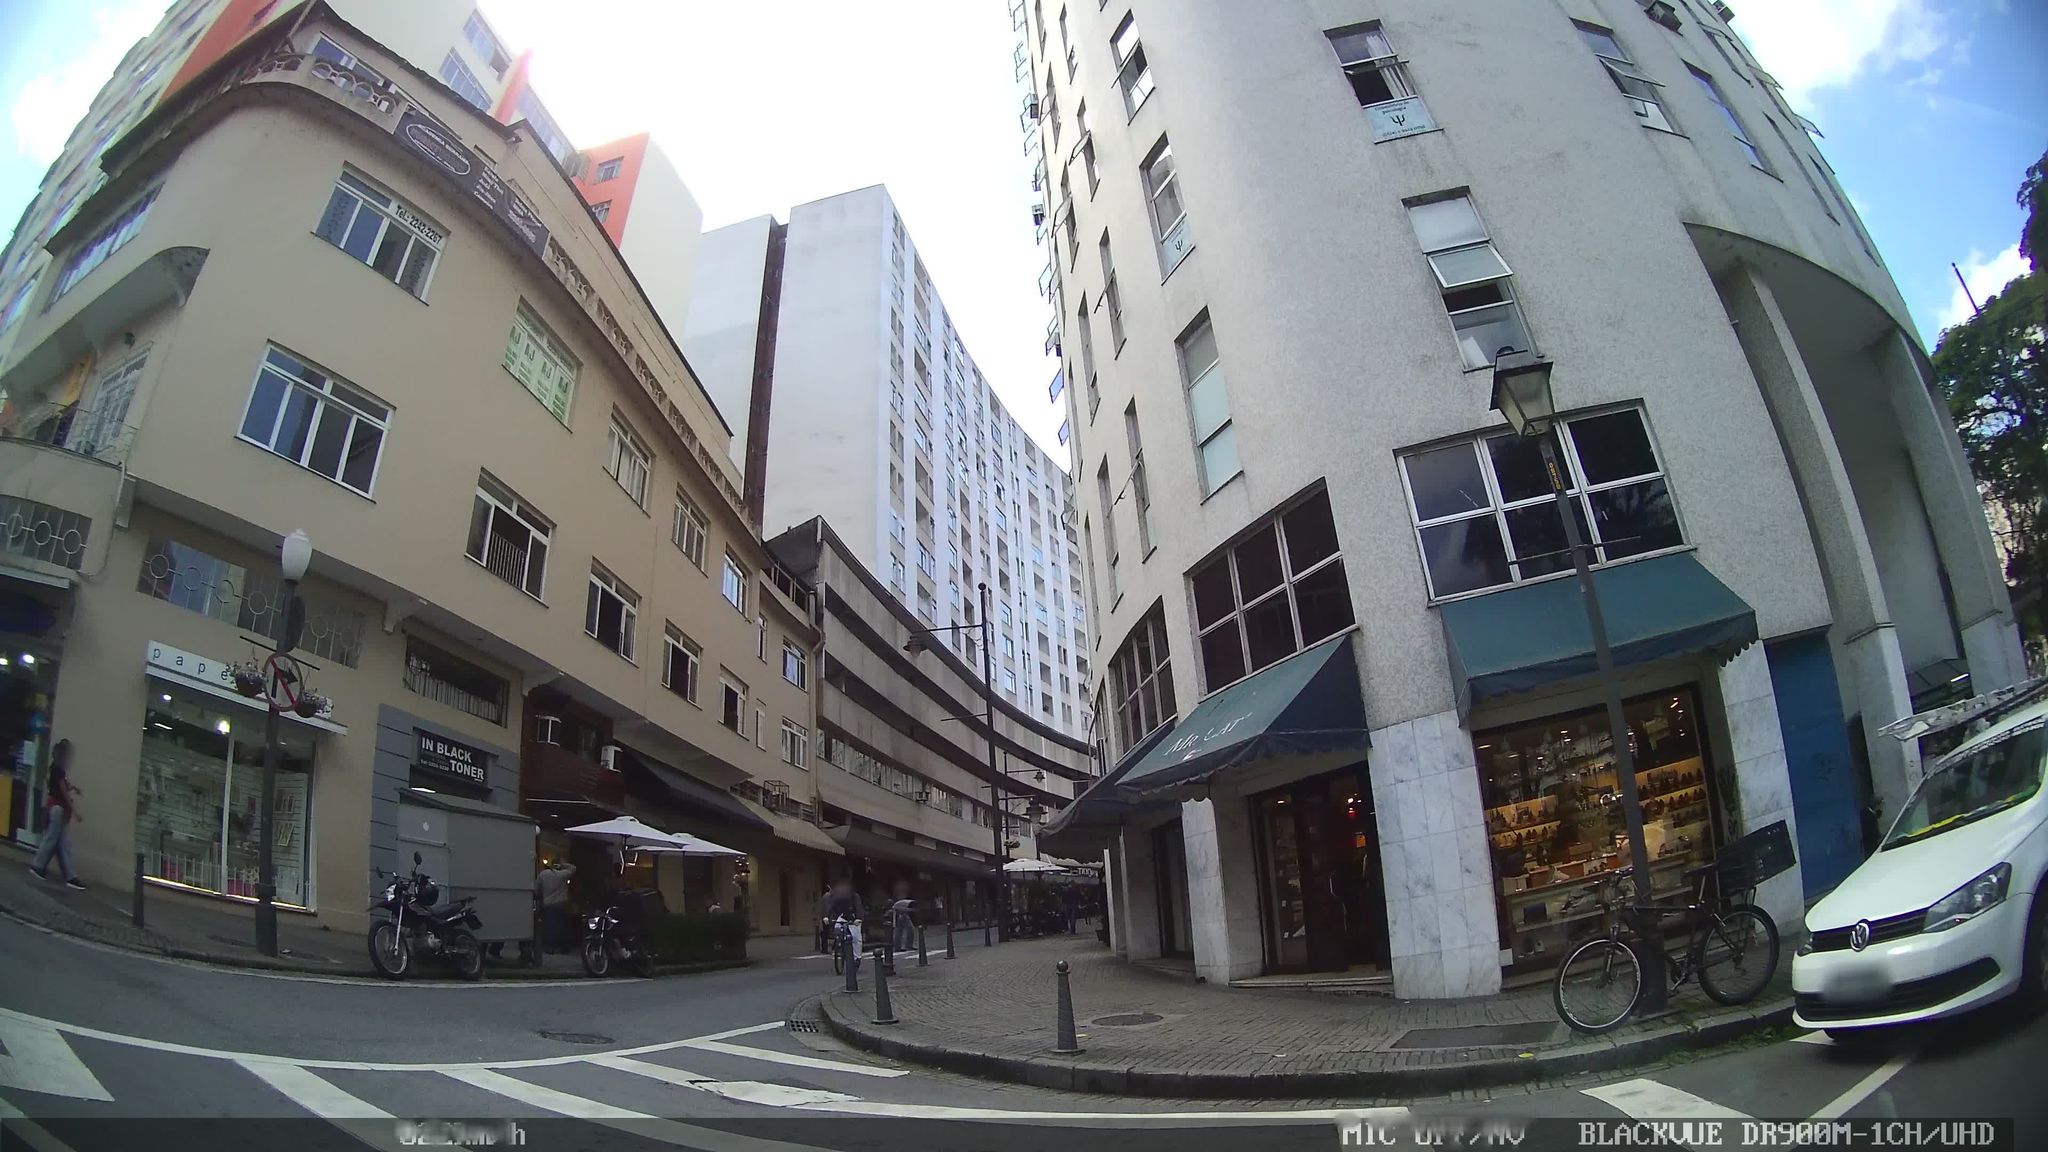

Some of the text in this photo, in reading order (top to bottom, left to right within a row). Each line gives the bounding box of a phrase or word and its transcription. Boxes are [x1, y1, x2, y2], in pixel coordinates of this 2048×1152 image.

[421, 736, 434, 752] IN
[436, 741, 472, 764] BLACK
[449, 759, 484, 780] TONER
